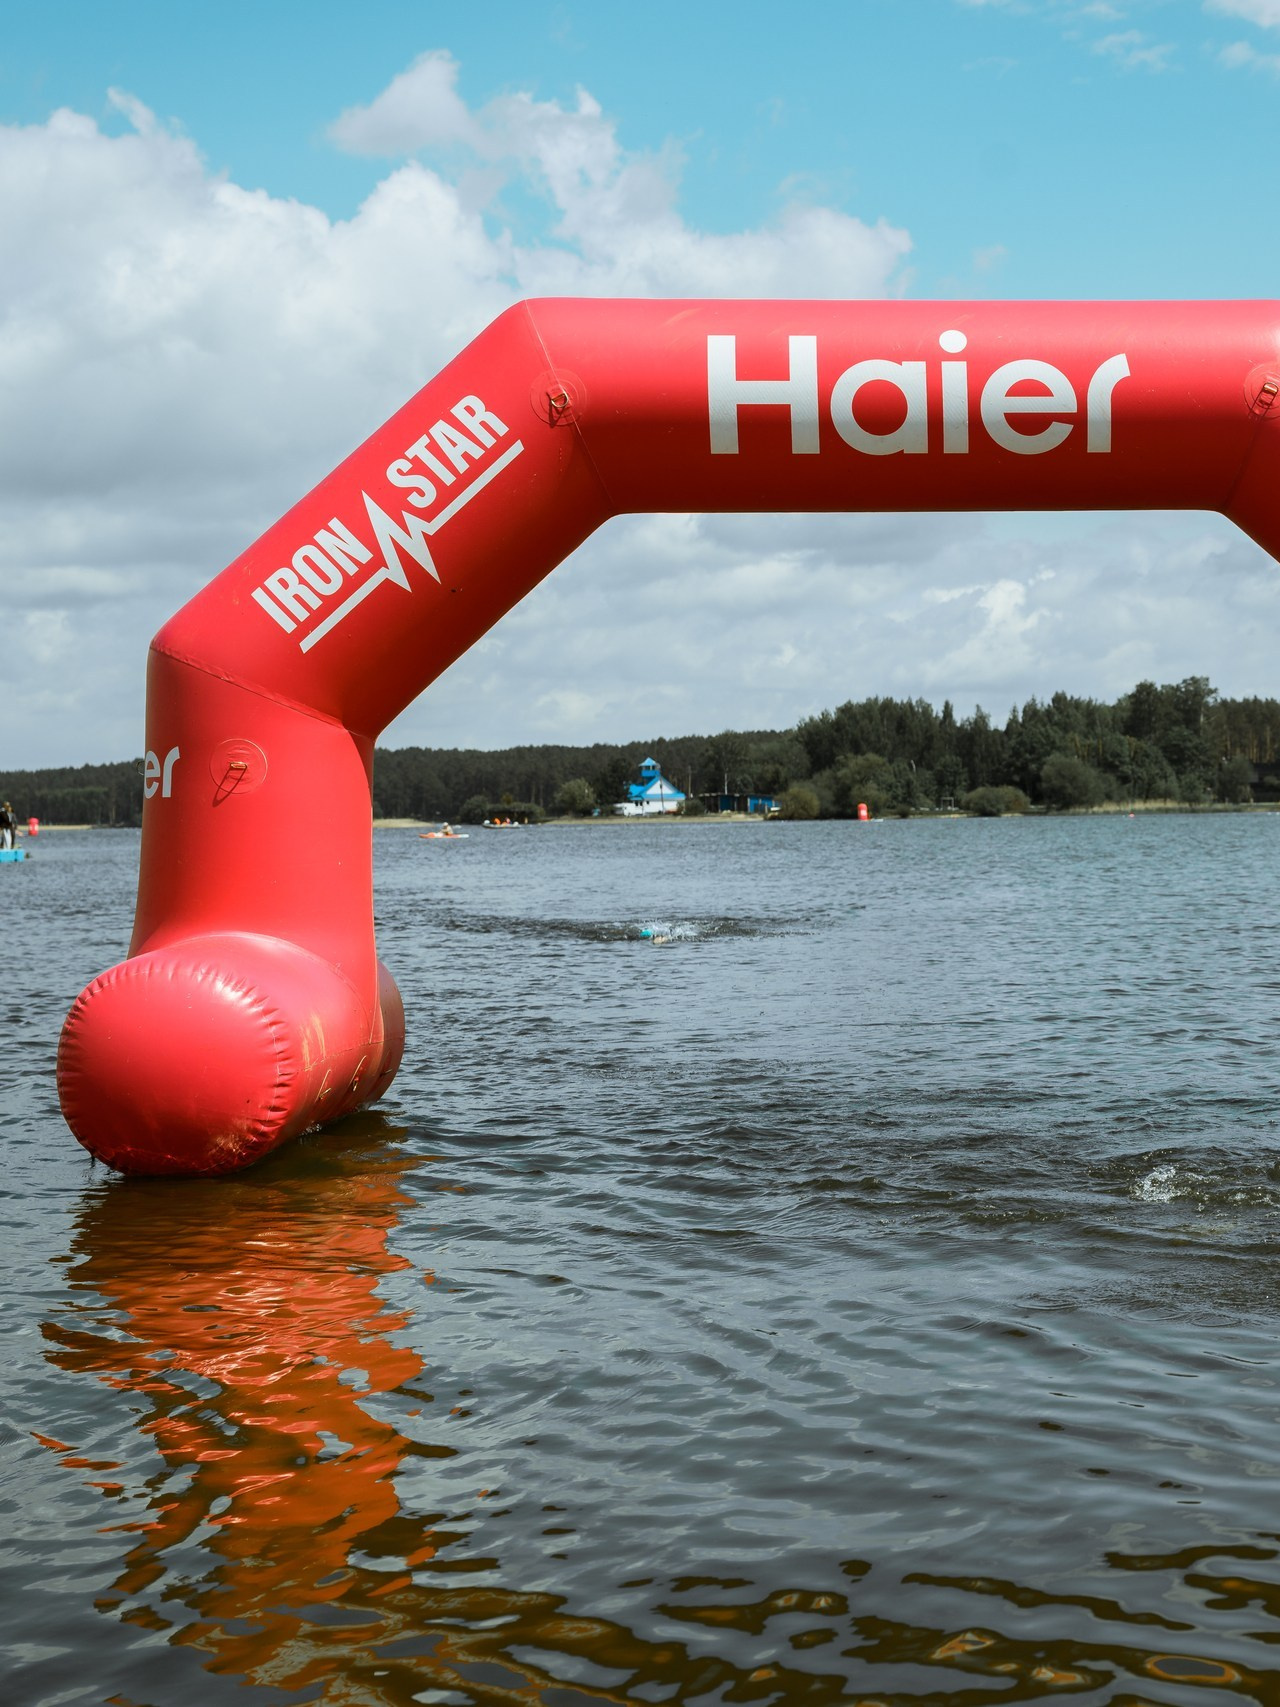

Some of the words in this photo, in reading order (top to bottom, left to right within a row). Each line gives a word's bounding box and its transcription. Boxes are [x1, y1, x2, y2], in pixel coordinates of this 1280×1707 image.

[707, 330, 1131, 456] Haier
[251, 517, 374, 634] IRON
[385, 394, 510, 509] STAR
